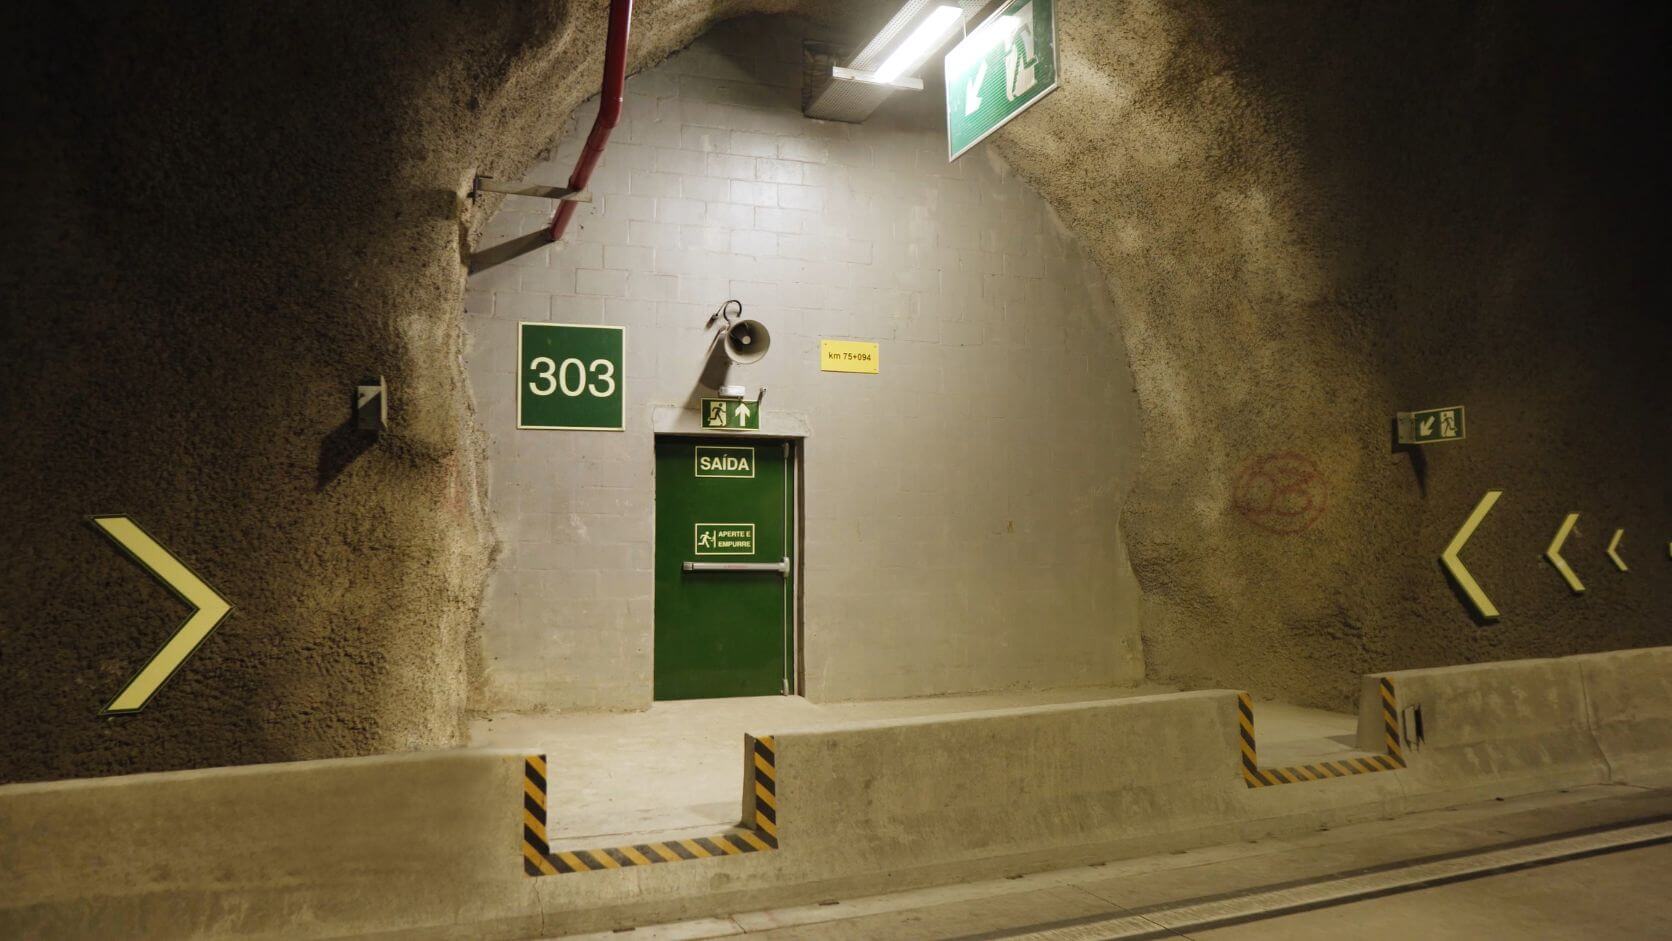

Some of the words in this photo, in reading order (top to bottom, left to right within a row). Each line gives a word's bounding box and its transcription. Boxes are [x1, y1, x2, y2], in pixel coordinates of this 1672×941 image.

[828, 352, 841, 360] km
[843, 352, 872, 361] 75+094
[529, 356, 615, 398] 303
[700, 453, 750, 471] SAÍDA
[718, 530, 745, 538] APERTE
[745, 530, 751, 538] E
[717, 540, 751, 548] EMPURRE
